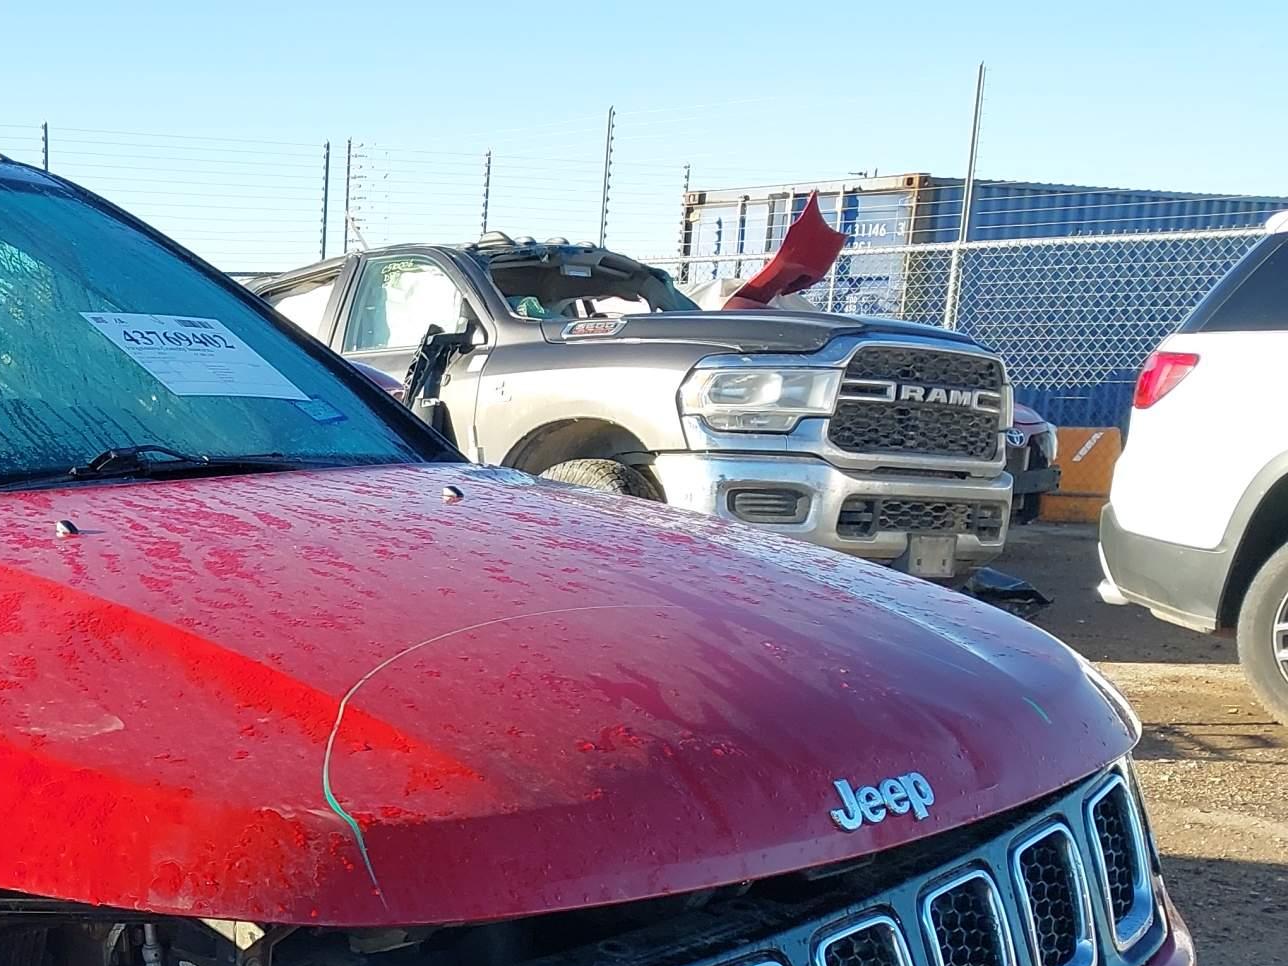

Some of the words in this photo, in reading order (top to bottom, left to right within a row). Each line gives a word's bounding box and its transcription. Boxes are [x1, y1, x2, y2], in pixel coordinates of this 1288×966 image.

[896, 222, 906, 237] 3
[122, 329, 236, 350] 43769402
[900, 384, 972, 407] RAM
[829, 771, 935, 832] Jeep
